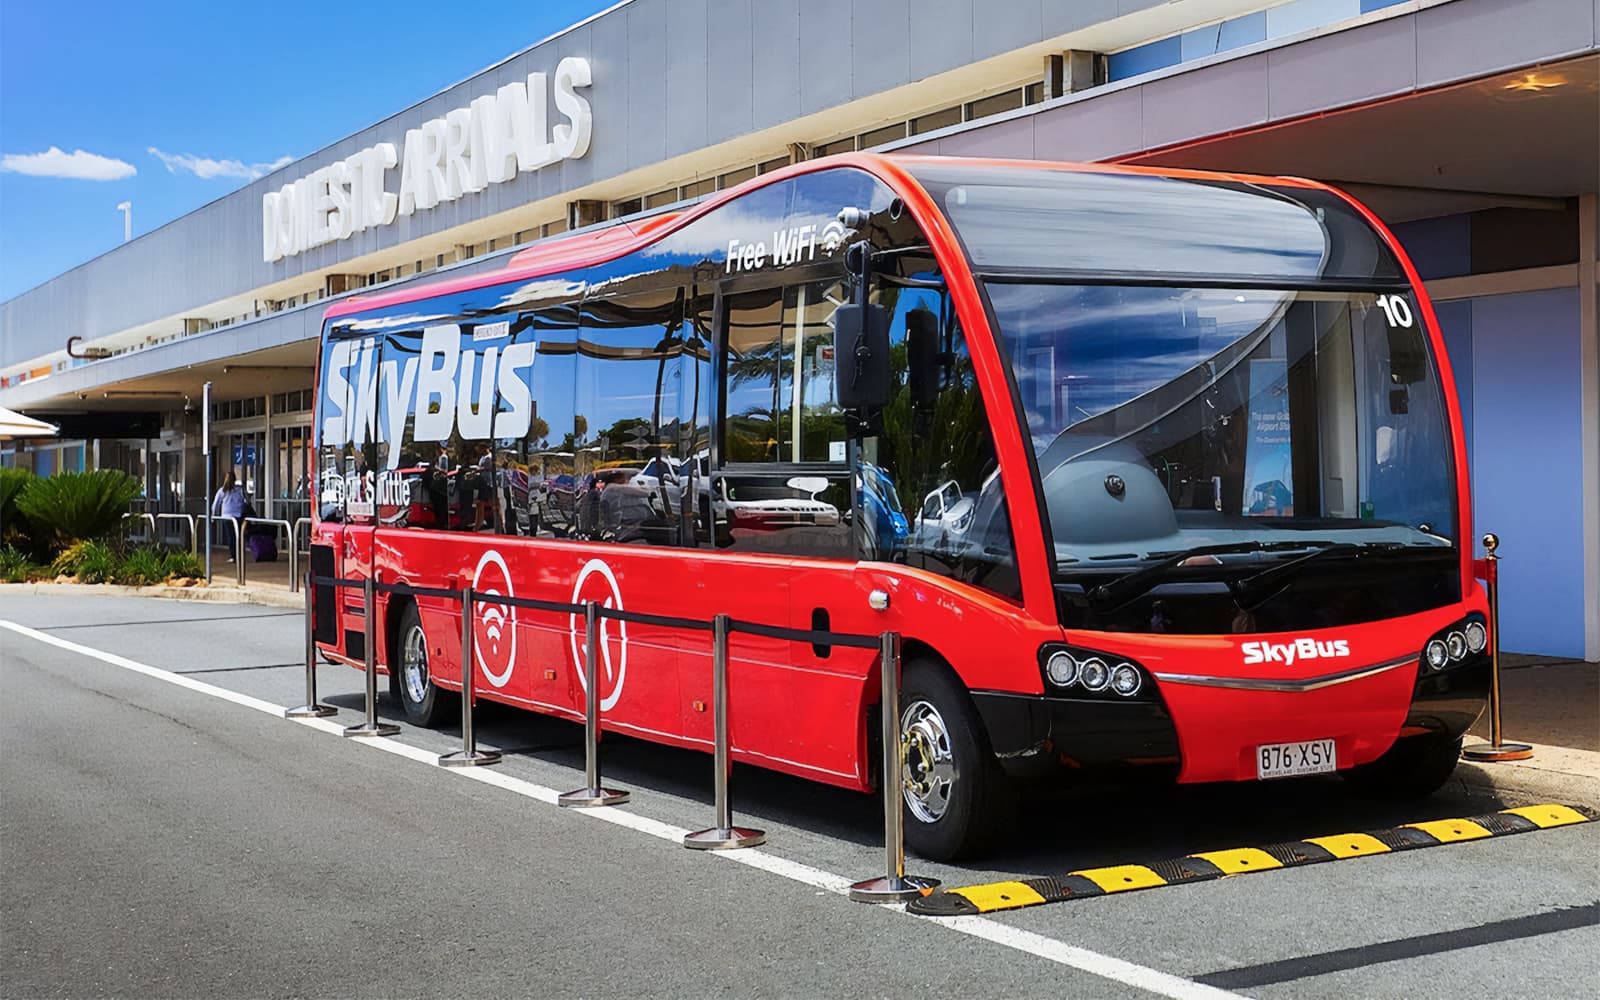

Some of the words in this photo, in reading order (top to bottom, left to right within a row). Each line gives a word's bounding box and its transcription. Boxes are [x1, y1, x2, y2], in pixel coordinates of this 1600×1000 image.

[262, 142, 398, 264] DOMESTIC
[399, 56, 593, 216] ARRIVALS
[725, 239, 766, 274] Free
[772, 224, 817, 267] WiFi
[1375, 293, 1413, 328] 10
[322, 323, 537, 471] SkyBus
[1241, 638, 1350, 666] SkyBus
